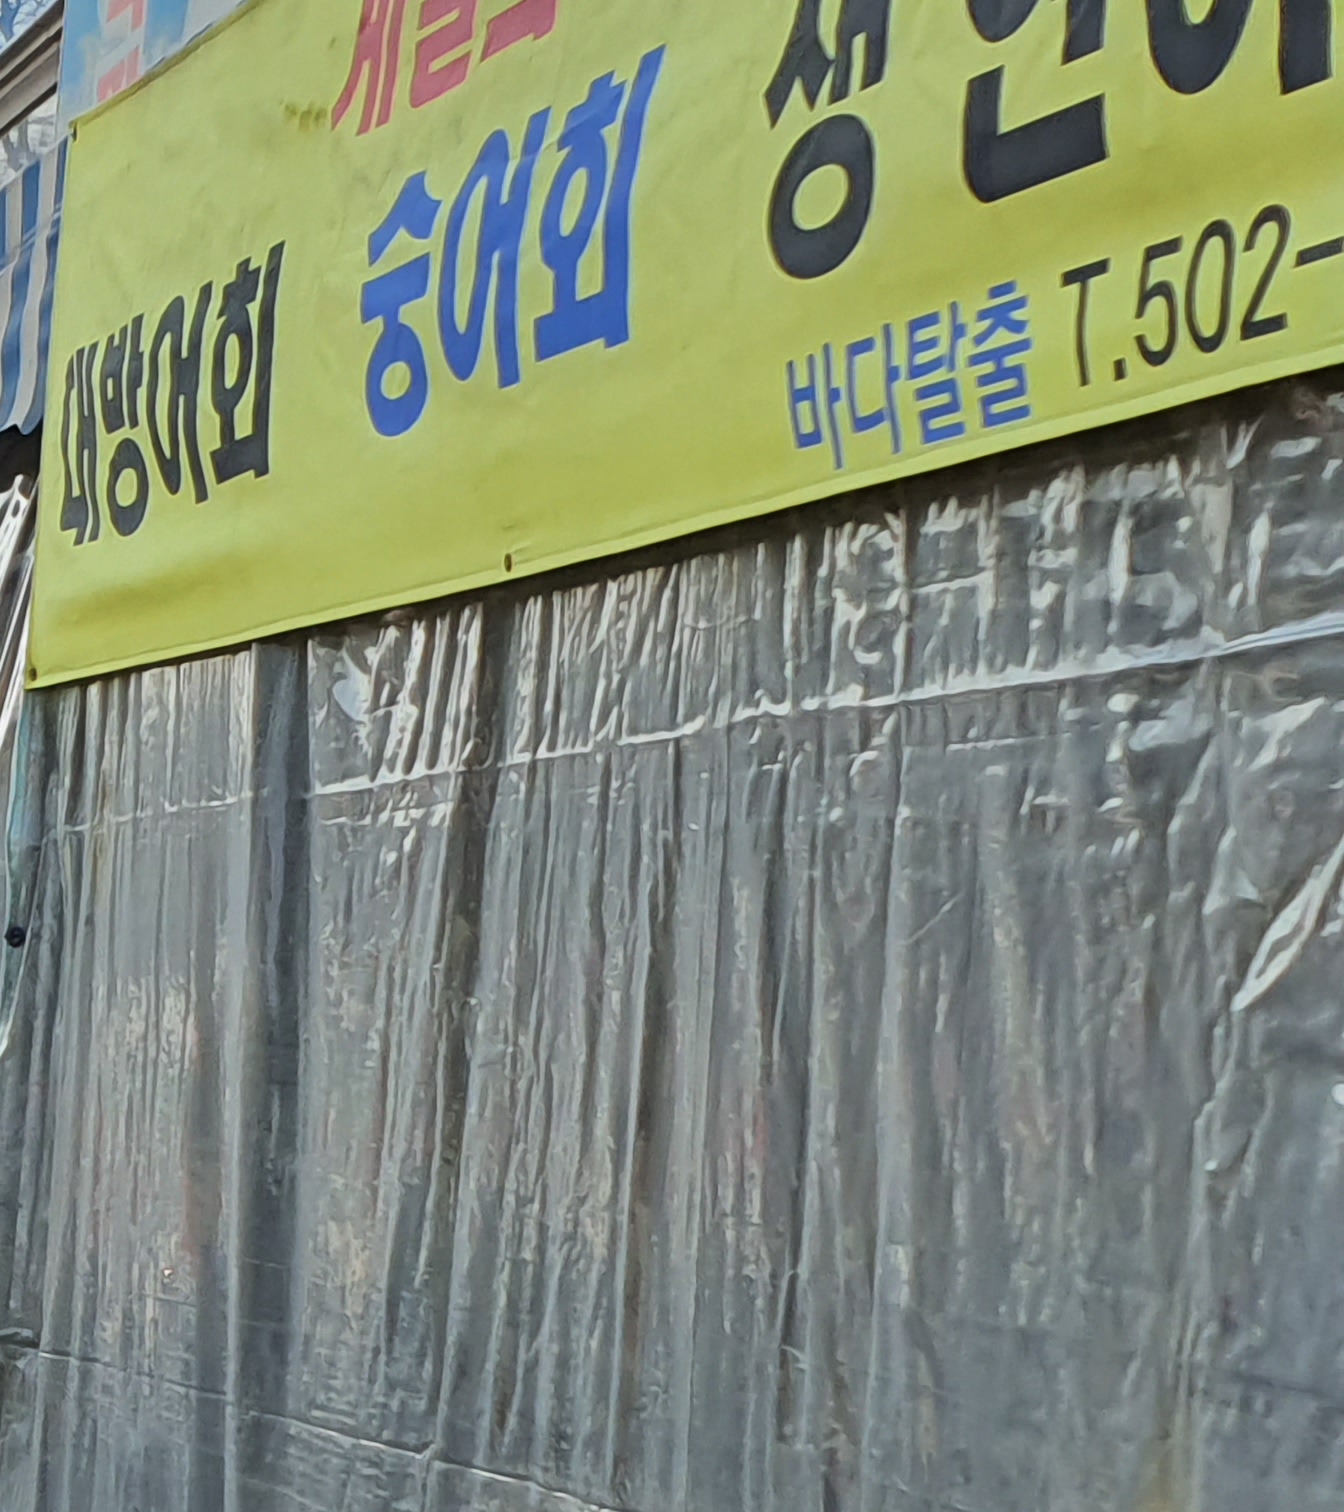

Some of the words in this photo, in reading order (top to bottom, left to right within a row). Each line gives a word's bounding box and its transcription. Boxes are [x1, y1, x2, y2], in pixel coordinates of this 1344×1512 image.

[59, 240, 286, 547] 대방어회
[360, 43, 667, 438] 송어회
[786, 279, 1033, 470] 바다탈출
